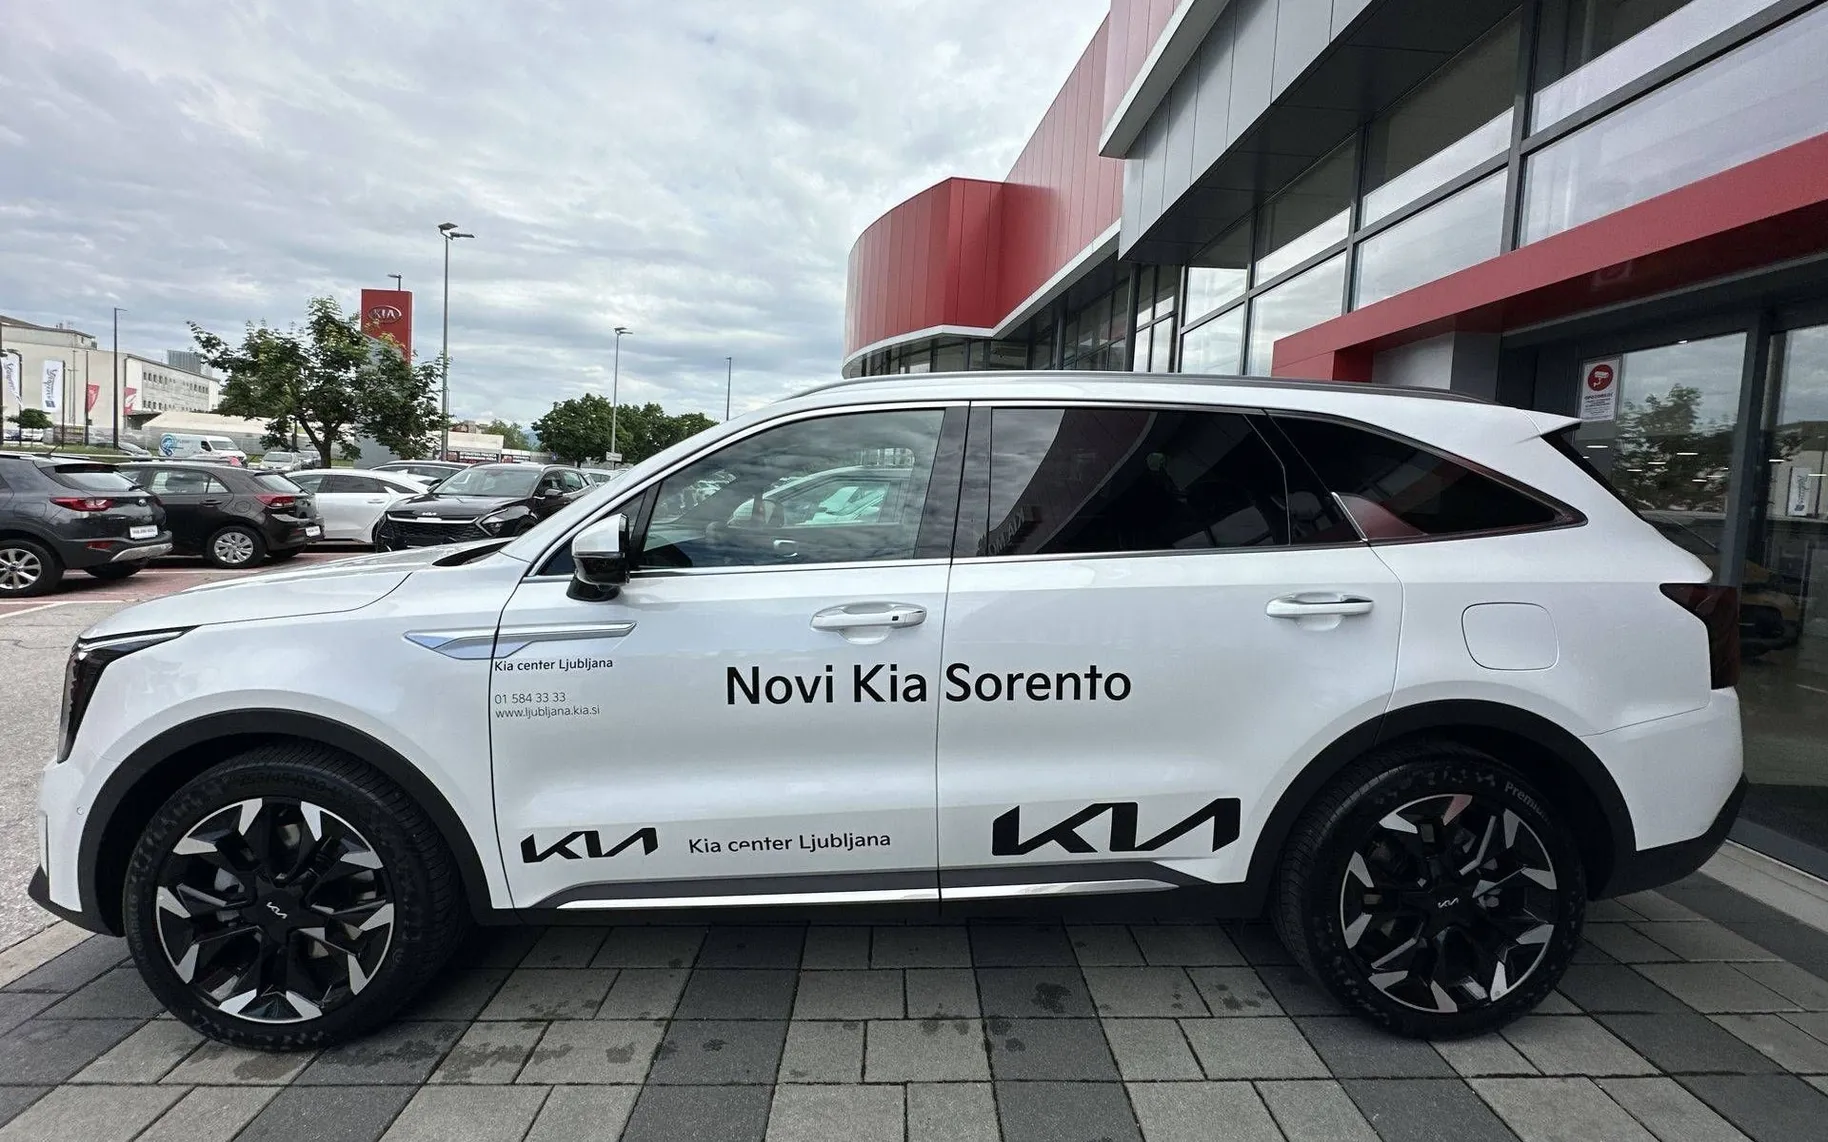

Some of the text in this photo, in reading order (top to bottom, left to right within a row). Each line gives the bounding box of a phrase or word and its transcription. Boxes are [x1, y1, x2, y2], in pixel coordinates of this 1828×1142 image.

[373, 308, 396, 319] KIA
[494, 658, 614, 672] Kia center Ljubljana
[726, 662, 1132, 705] Novi Kia Sorento
[494, 692, 566, 704] 01 584 33 33
[495, 705, 600, 719] www.ljubljana.kia.si
[992, 797, 1241, 856] KIA
[520, 827, 659, 863] KIA
[689, 832, 891, 854] Kia center Ljubljana
